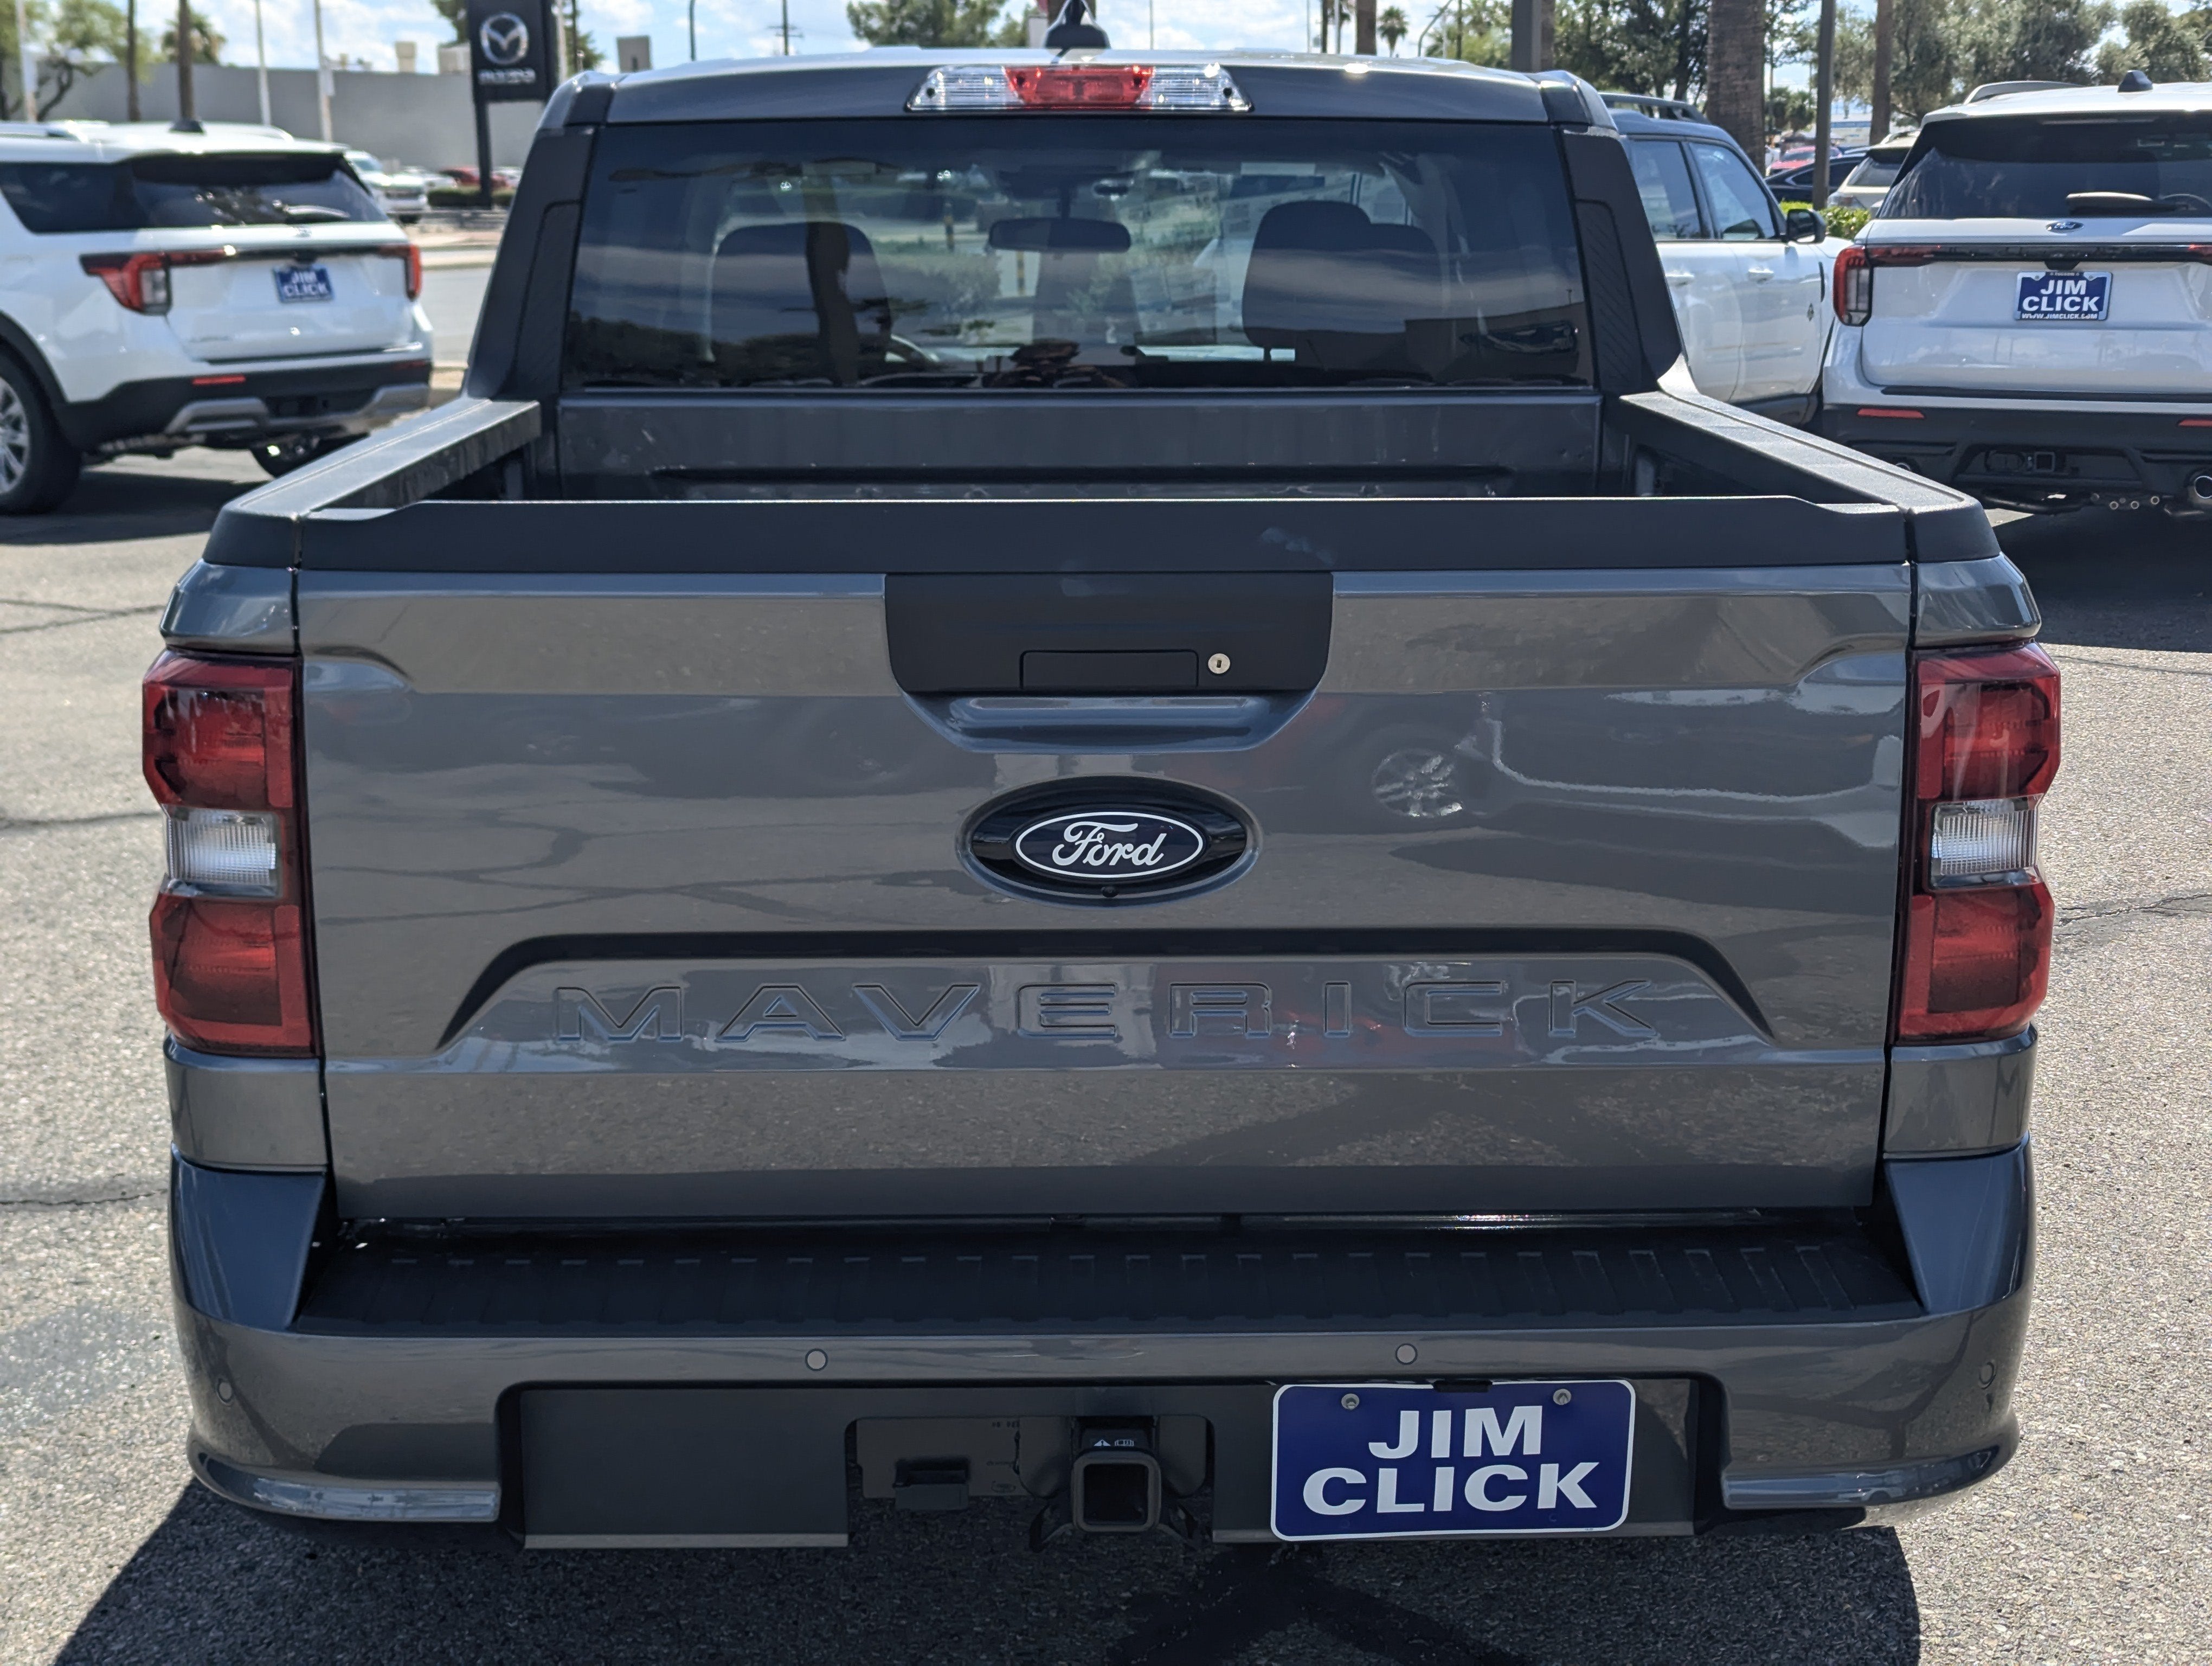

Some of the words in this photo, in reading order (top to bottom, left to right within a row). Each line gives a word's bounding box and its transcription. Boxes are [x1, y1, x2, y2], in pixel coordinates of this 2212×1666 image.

[284, 283, 329, 297] CLICK
[291, 271, 317, 284] JIM
[2040, 279, 2087, 295] JIM
[2022, 296, 2100, 312] CLICK
[1052, 821, 1167, 866] Ford
[556, 979, 1658, 1042] MAVERICK
[1368, 1405, 1543, 1459] JIM
[1303, 1462, 1600, 1516] CLICK
